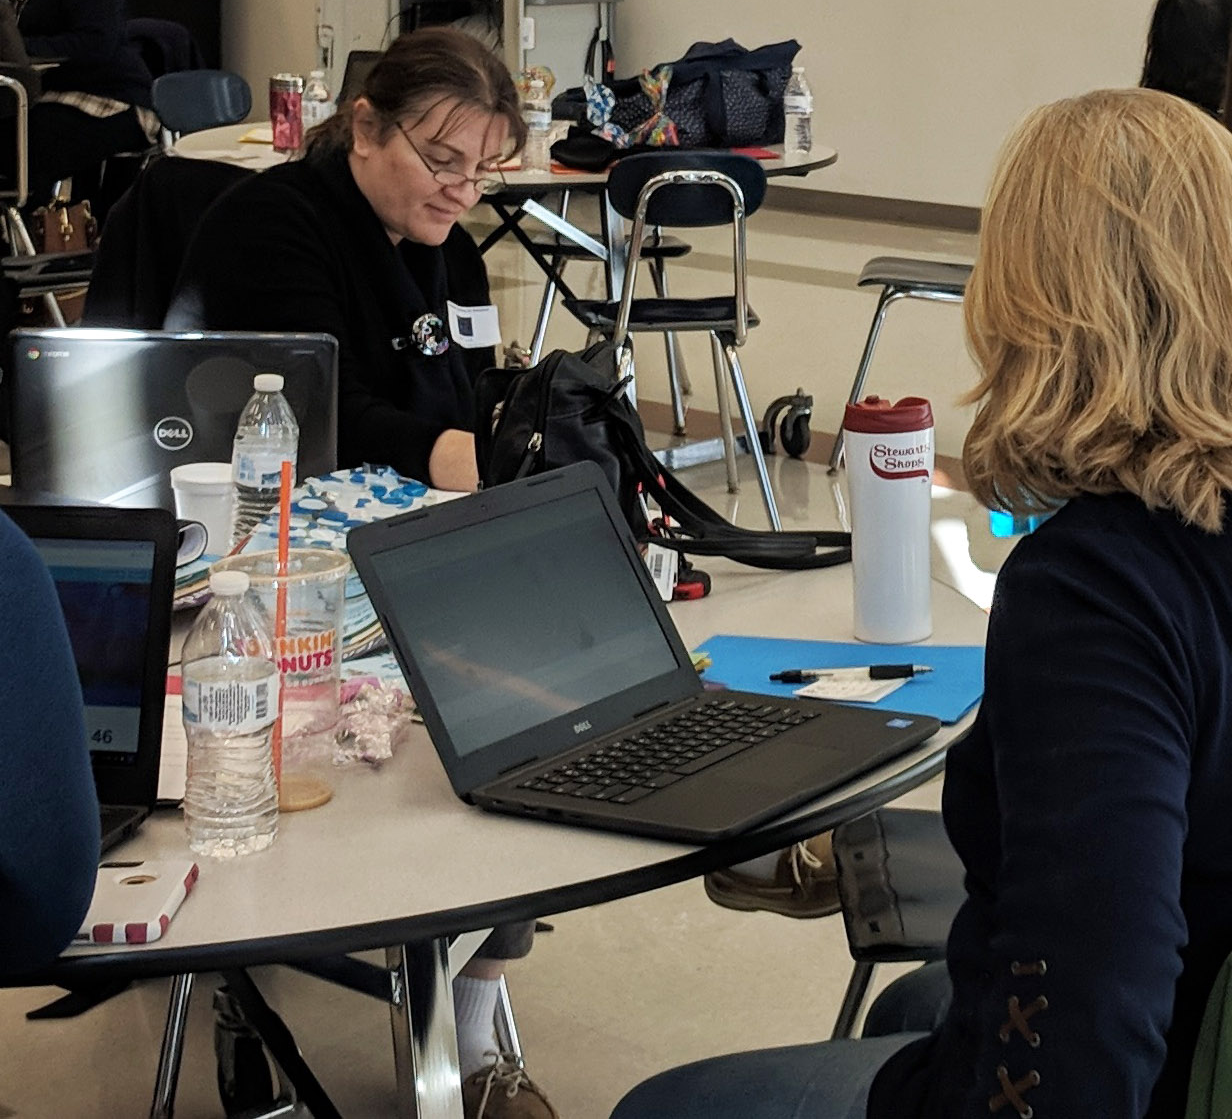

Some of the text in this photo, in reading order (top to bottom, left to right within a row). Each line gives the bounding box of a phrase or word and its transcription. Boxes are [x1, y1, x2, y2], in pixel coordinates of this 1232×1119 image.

[158, 428, 189, 438] DELL
[884, 457, 925, 470] Shops
[91, 729, 113, 744] 46
